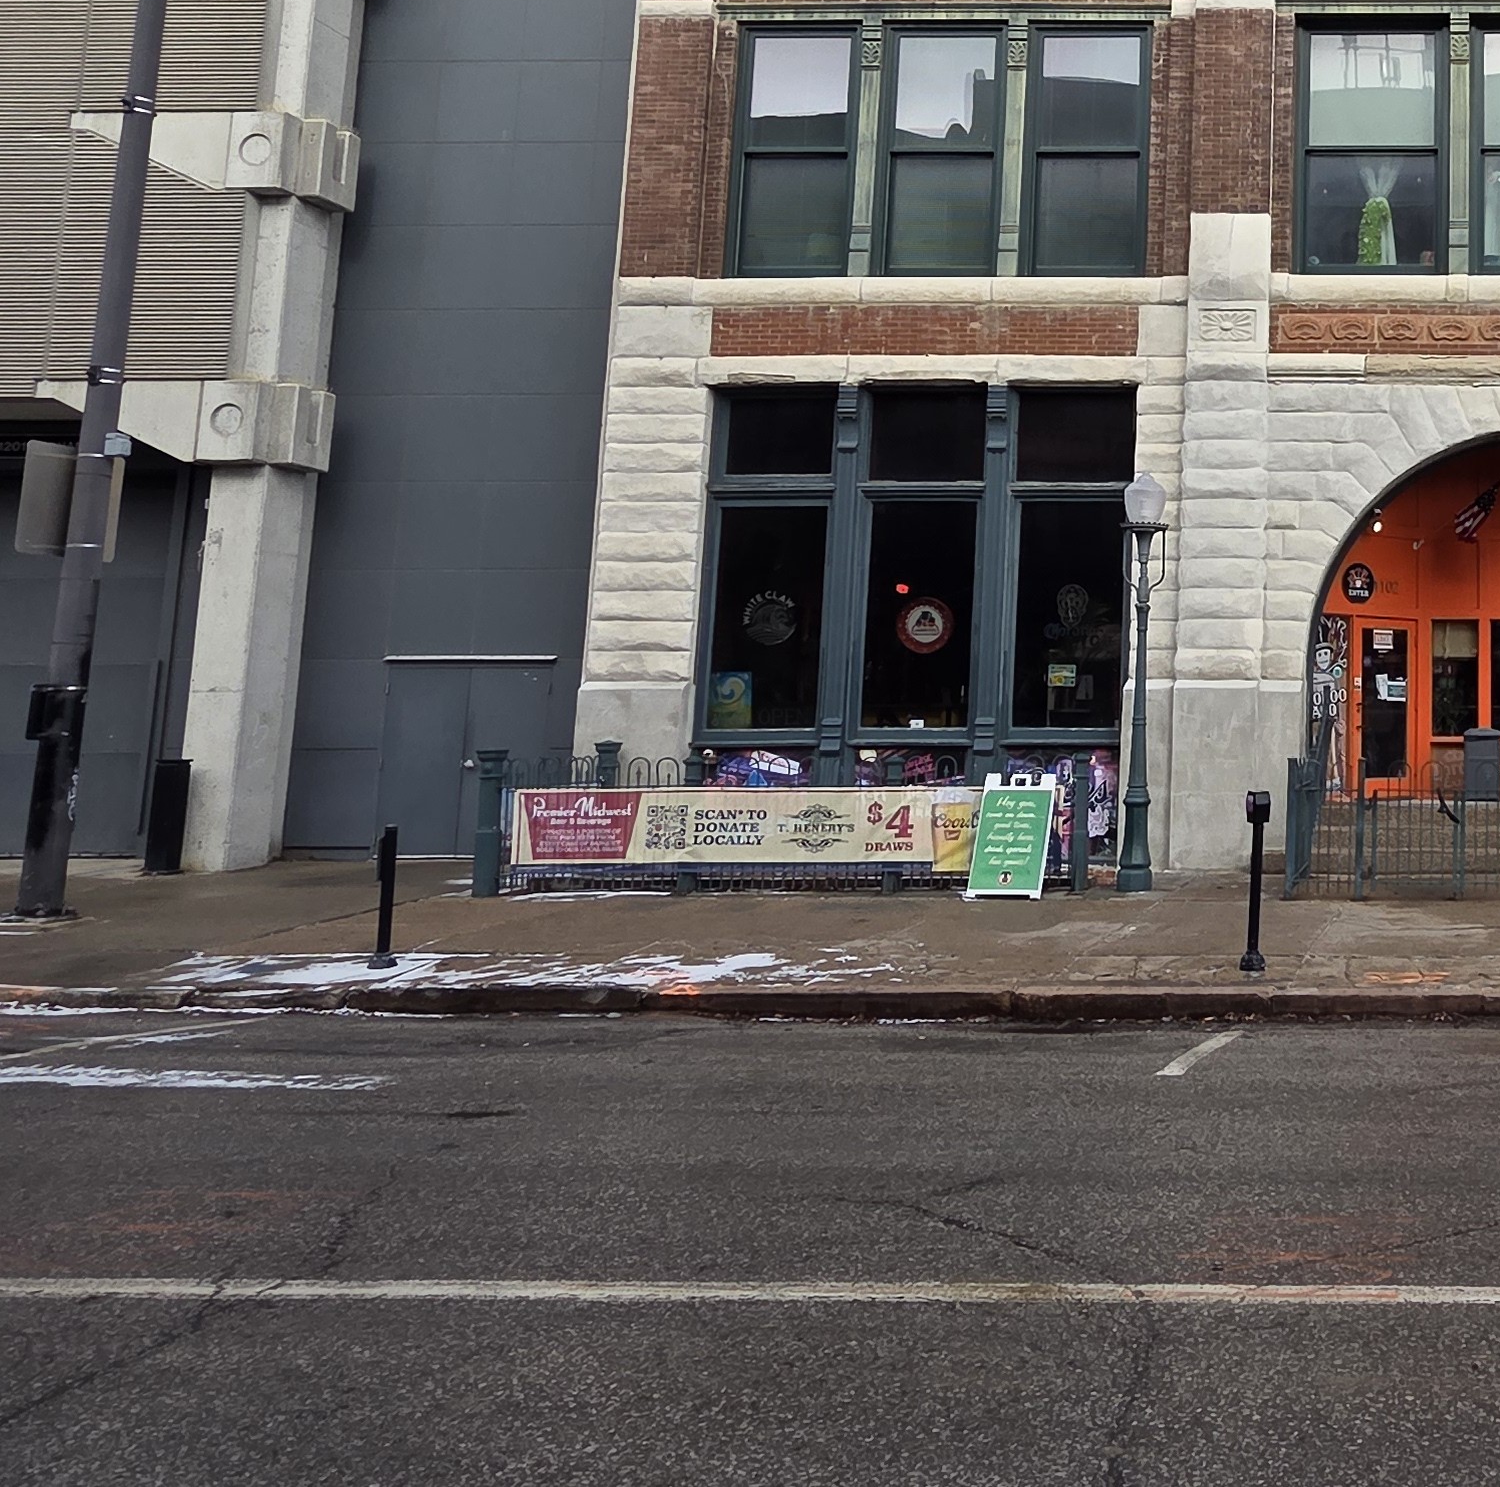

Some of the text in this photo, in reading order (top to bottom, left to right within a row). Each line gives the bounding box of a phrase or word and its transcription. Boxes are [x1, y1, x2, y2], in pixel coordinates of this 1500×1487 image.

[742, 590, 796, 626] WHITE CLAW
[575, 796, 632, 817] Midwest
[748, 809, 768, 820] TO
[694, 822, 760, 833] DONATE
[691, 834, 766, 846] LOCALLY
[864, 841, 914, 852] DRAWS
